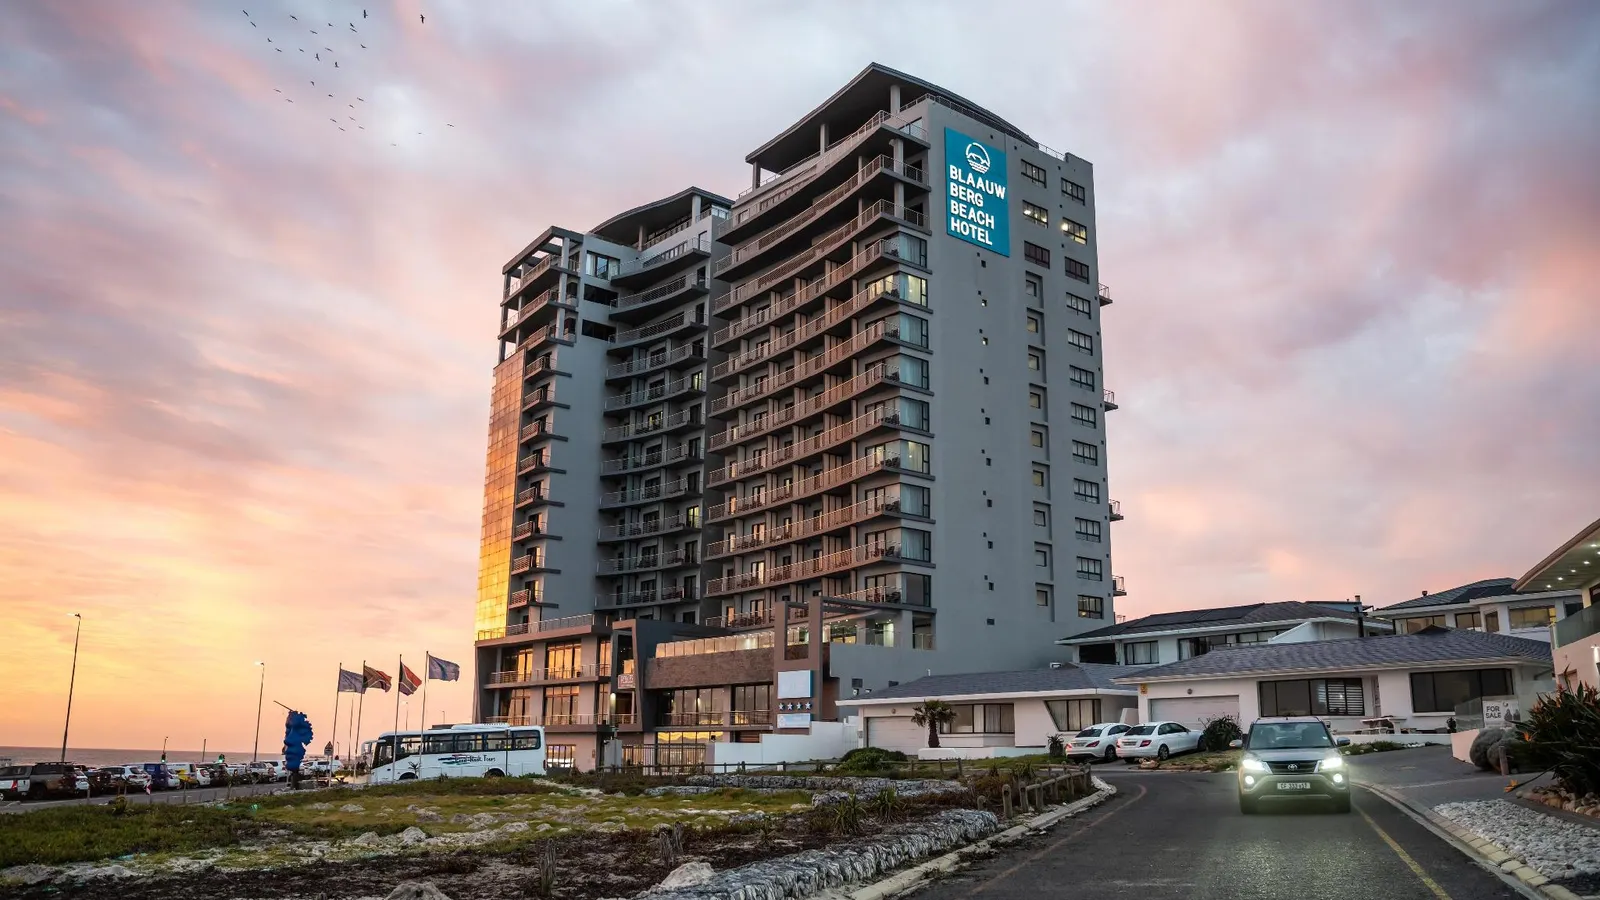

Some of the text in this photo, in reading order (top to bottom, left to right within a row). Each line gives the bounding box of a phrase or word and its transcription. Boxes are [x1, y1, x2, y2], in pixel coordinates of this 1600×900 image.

[949, 164, 1006, 200] BLAAUW
[949, 181, 984, 207] BERG
[950, 199, 995, 230] BEACH
[951, 216, 993, 246] HOTEL
